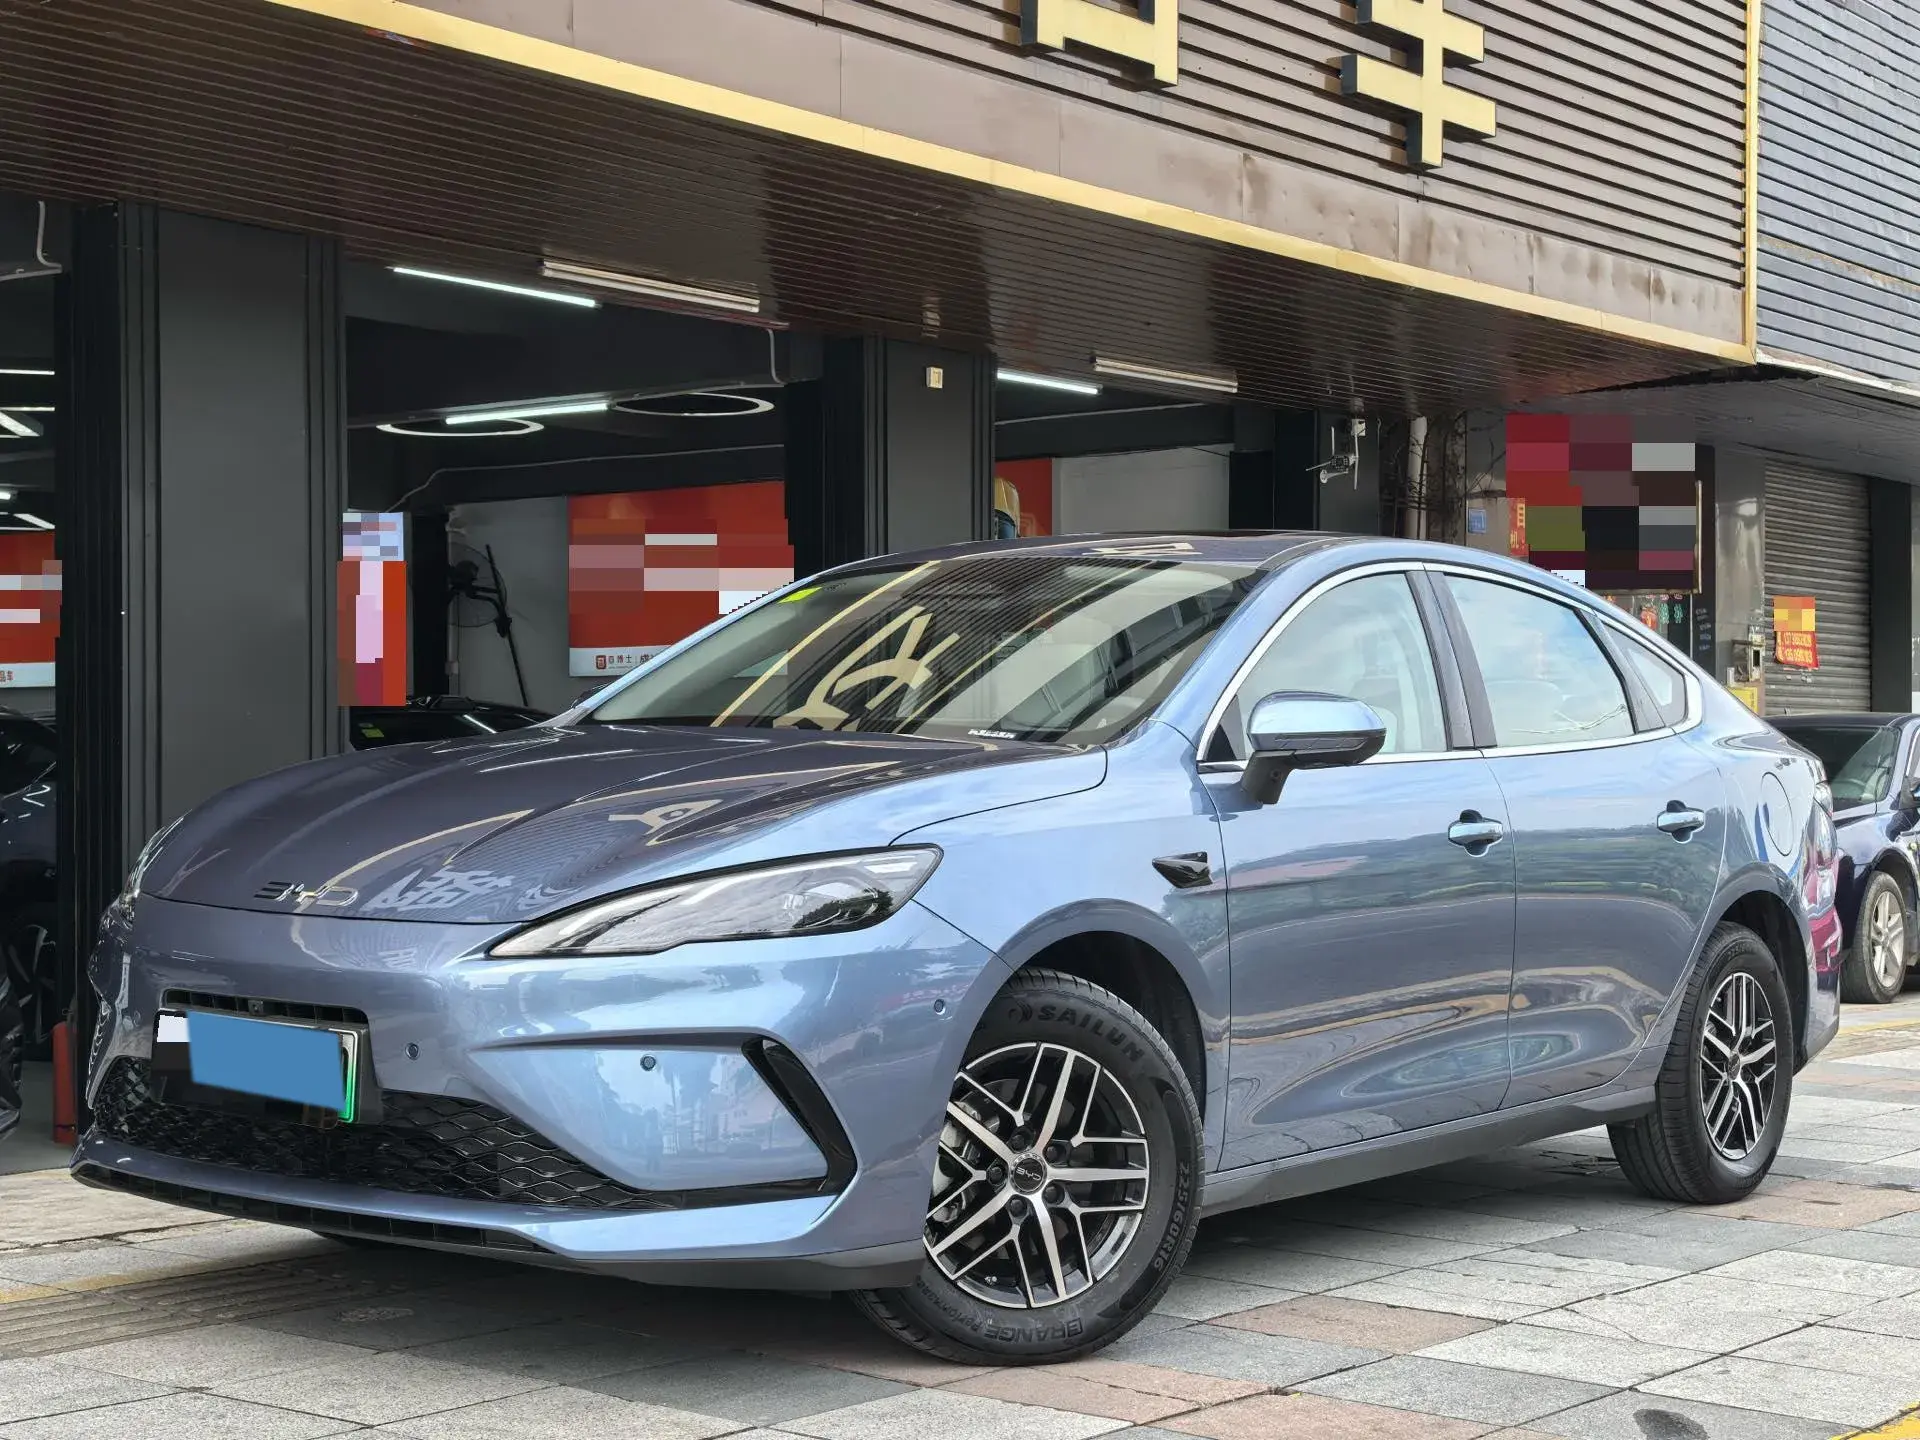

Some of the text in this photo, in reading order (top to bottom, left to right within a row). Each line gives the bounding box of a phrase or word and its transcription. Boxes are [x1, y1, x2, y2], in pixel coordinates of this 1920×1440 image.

[253, 881, 358, 906] BYD
[1038, 1005, 1145, 1061] SAILUN
[1016, 1166, 1041, 1181] BYD
[1153, 1161, 1190, 1271] 225/60R16
